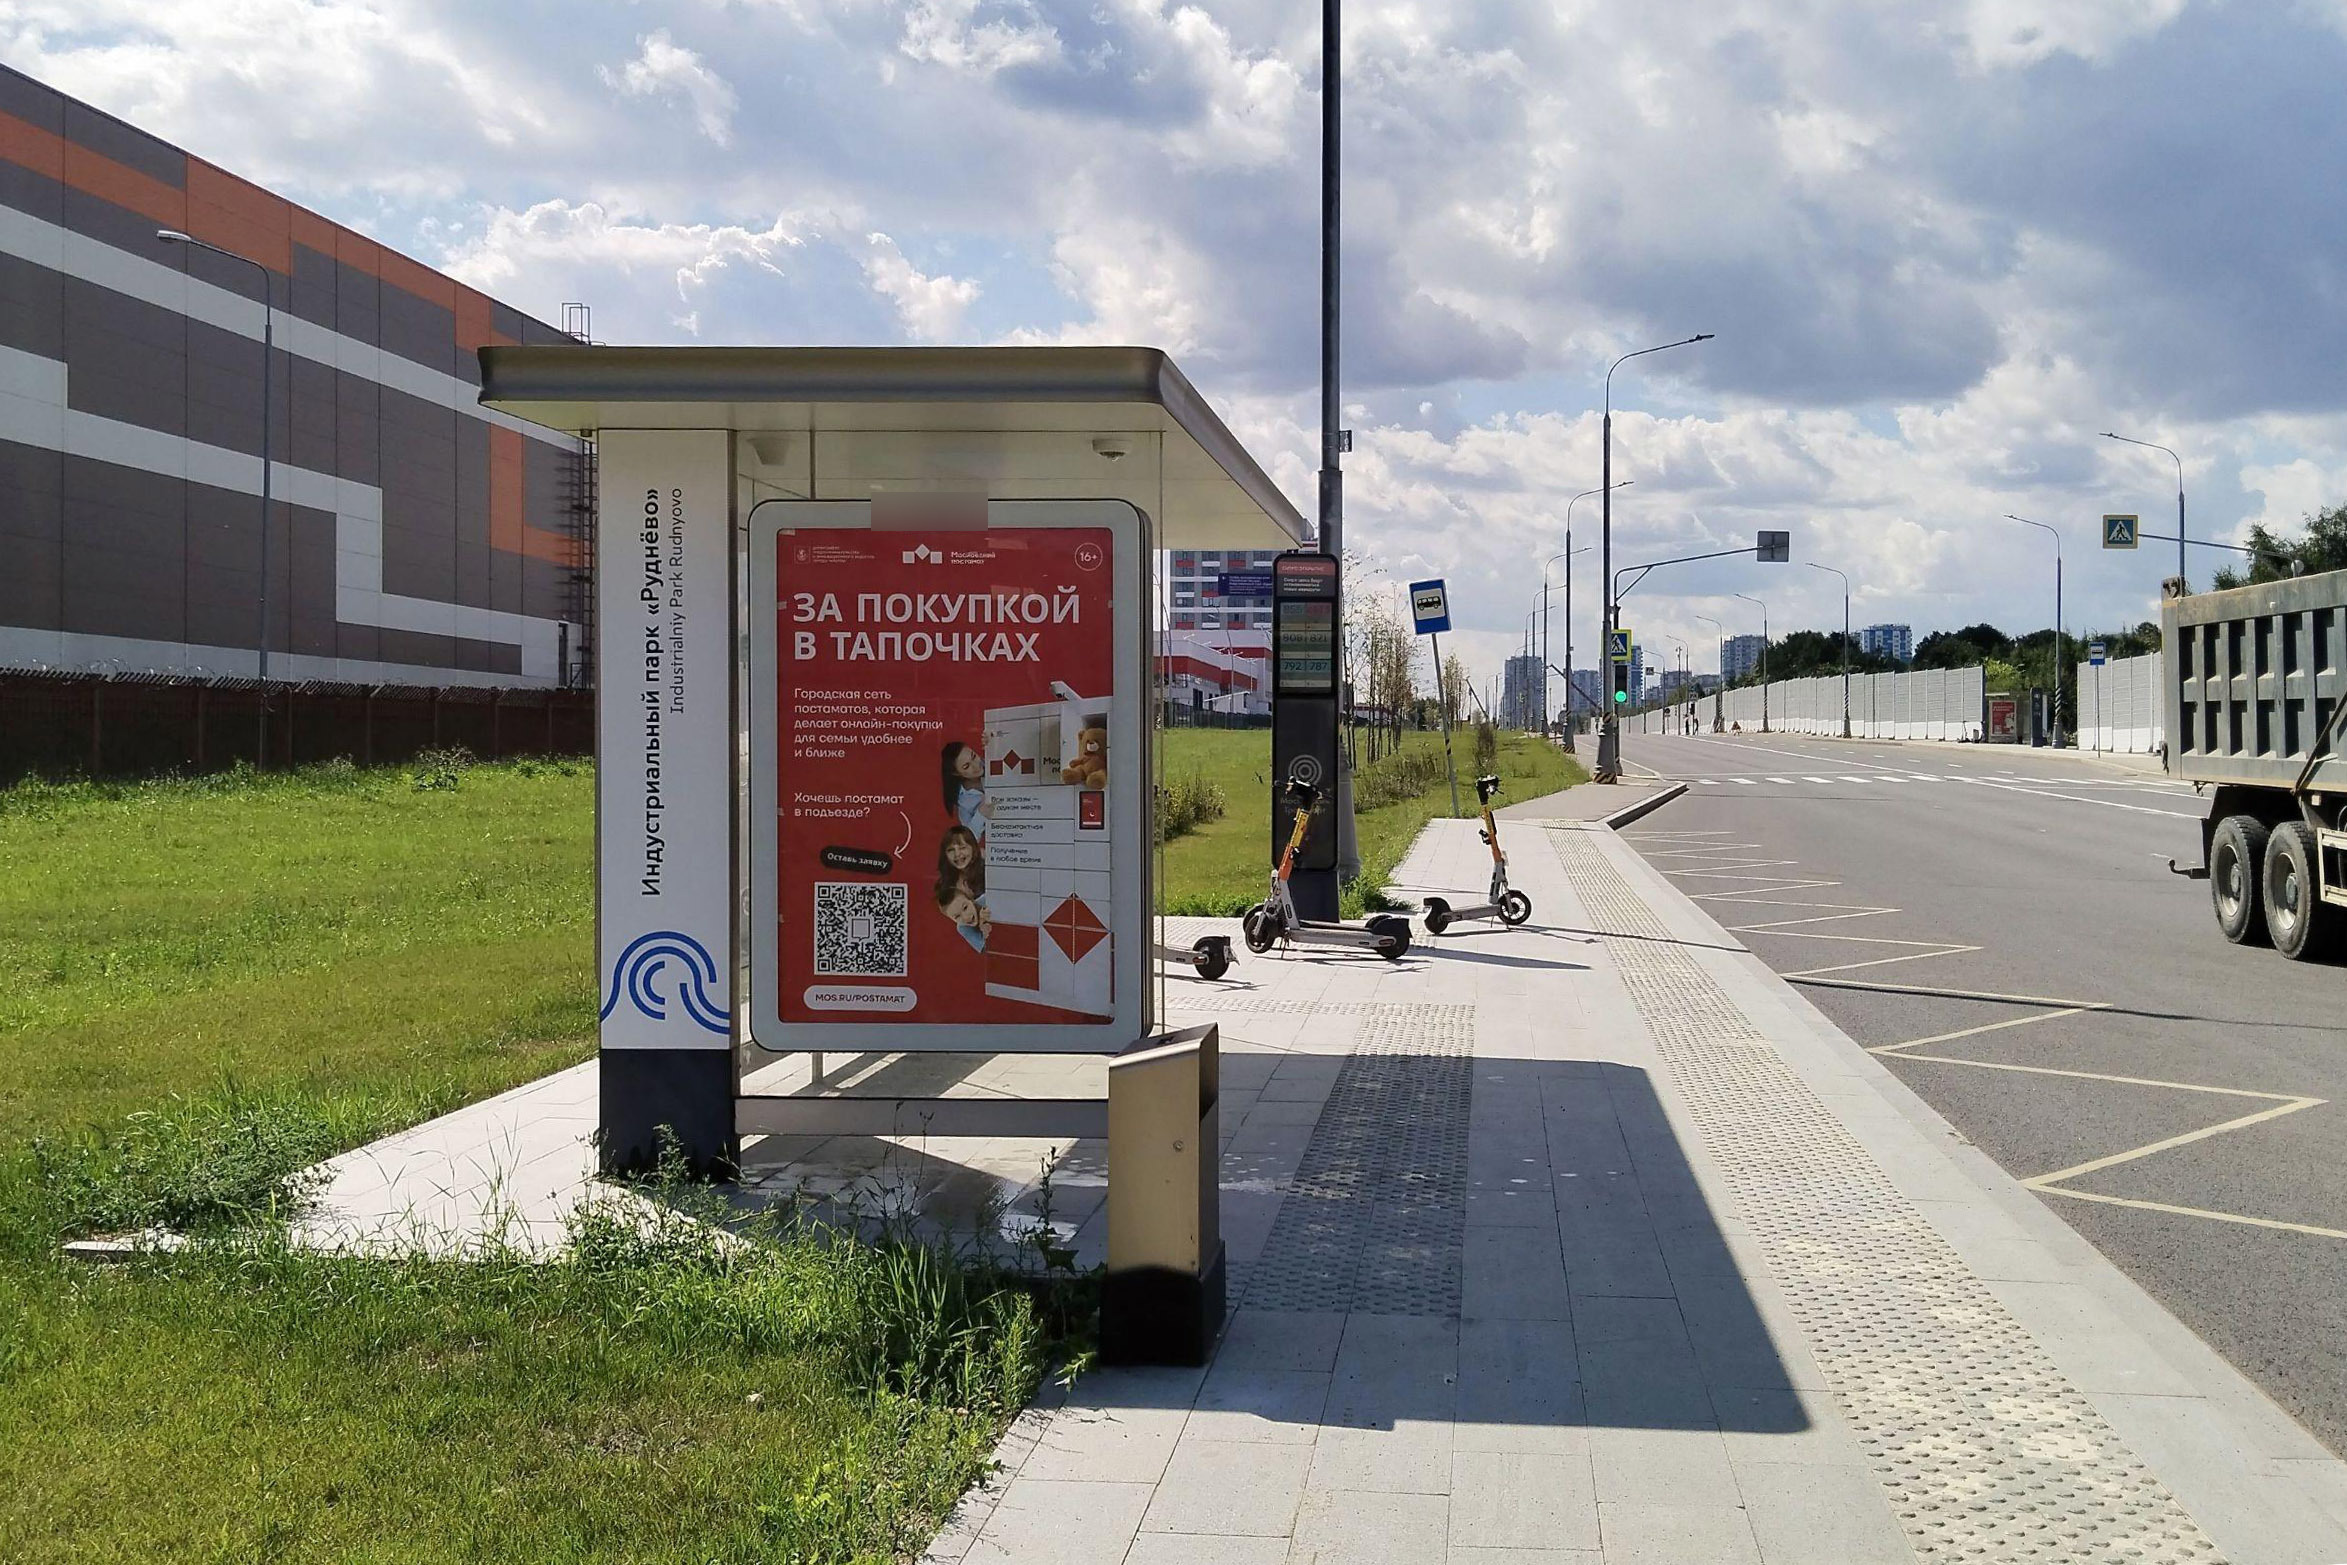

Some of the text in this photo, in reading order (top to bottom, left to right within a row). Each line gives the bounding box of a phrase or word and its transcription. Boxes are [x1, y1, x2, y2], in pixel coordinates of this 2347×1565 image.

[1079, 551, 1098, 563] 16+
[668, 487, 686, 714] Industrialniy Park Rudnyovo
[793, 585, 1080, 624] ЗА ПОКУПКОЙ
[794, 631, 1041, 662] В ТАПОЧКАХ
[1284, 661, 1302, 671] 792
[1309, 661, 1328, 671] 787
[640, 488, 665, 896] Индустриальный парк «Руднёво»
[794, 688, 892, 700] Городская сеть
[794, 704, 926, 716] постаматов, которая
[794, 718, 943, 731] делает онлайн-покупки
[794, 733, 913, 746] для семьи удобнее
[794, 747, 846, 758] и ближе
[794, 792, 904, 804] Хочешь постамат
[794, 806, 871, 819] в подъезде?
[827, 852, 888, 869] Оставь заявку
